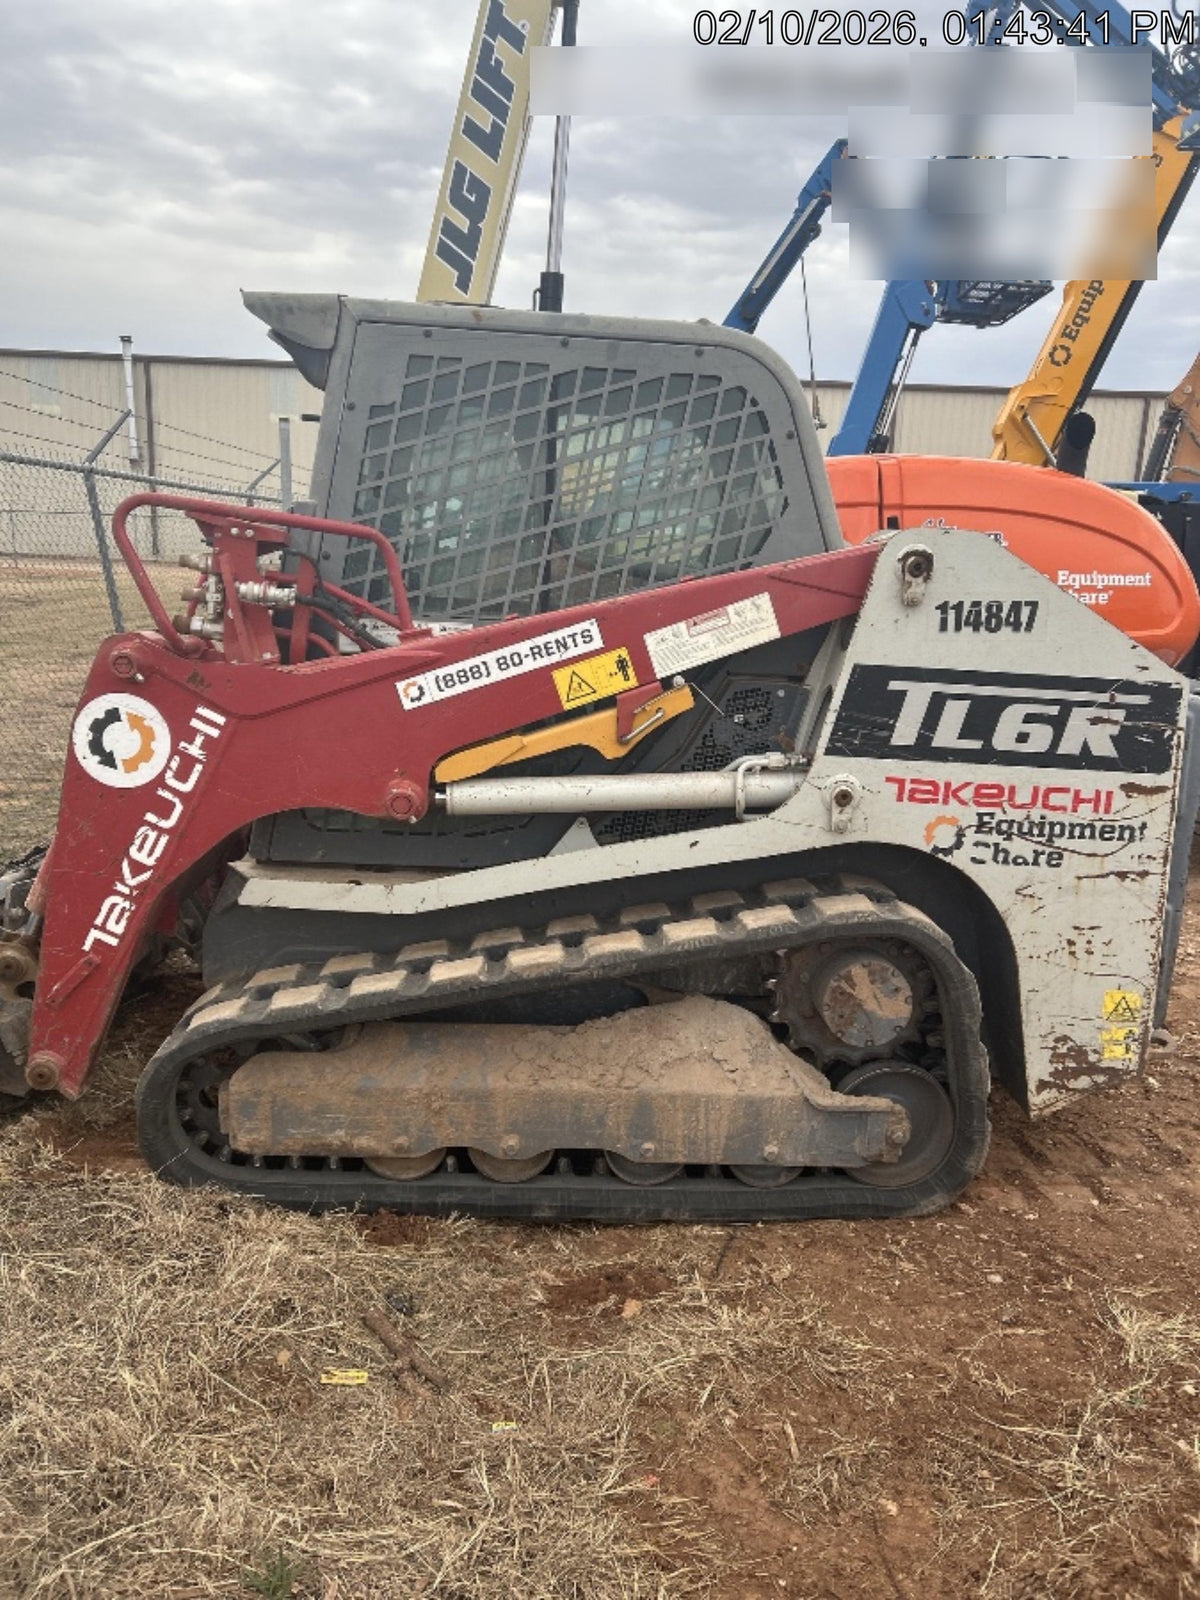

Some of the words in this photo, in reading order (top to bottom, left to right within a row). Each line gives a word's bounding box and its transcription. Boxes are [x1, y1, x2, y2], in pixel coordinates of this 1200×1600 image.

[434, 158, 493, 297] JLG
[1057, 570, 1152, 589] Equipment
[935, 600, 1039, 633] 114847
[434, 663, 491, 692] (888)
[495, 628, 595, 672] 80-RENTS
[887, 680, 1151, 759] TL6R
[974, 811, 1148, 844] Equipment
